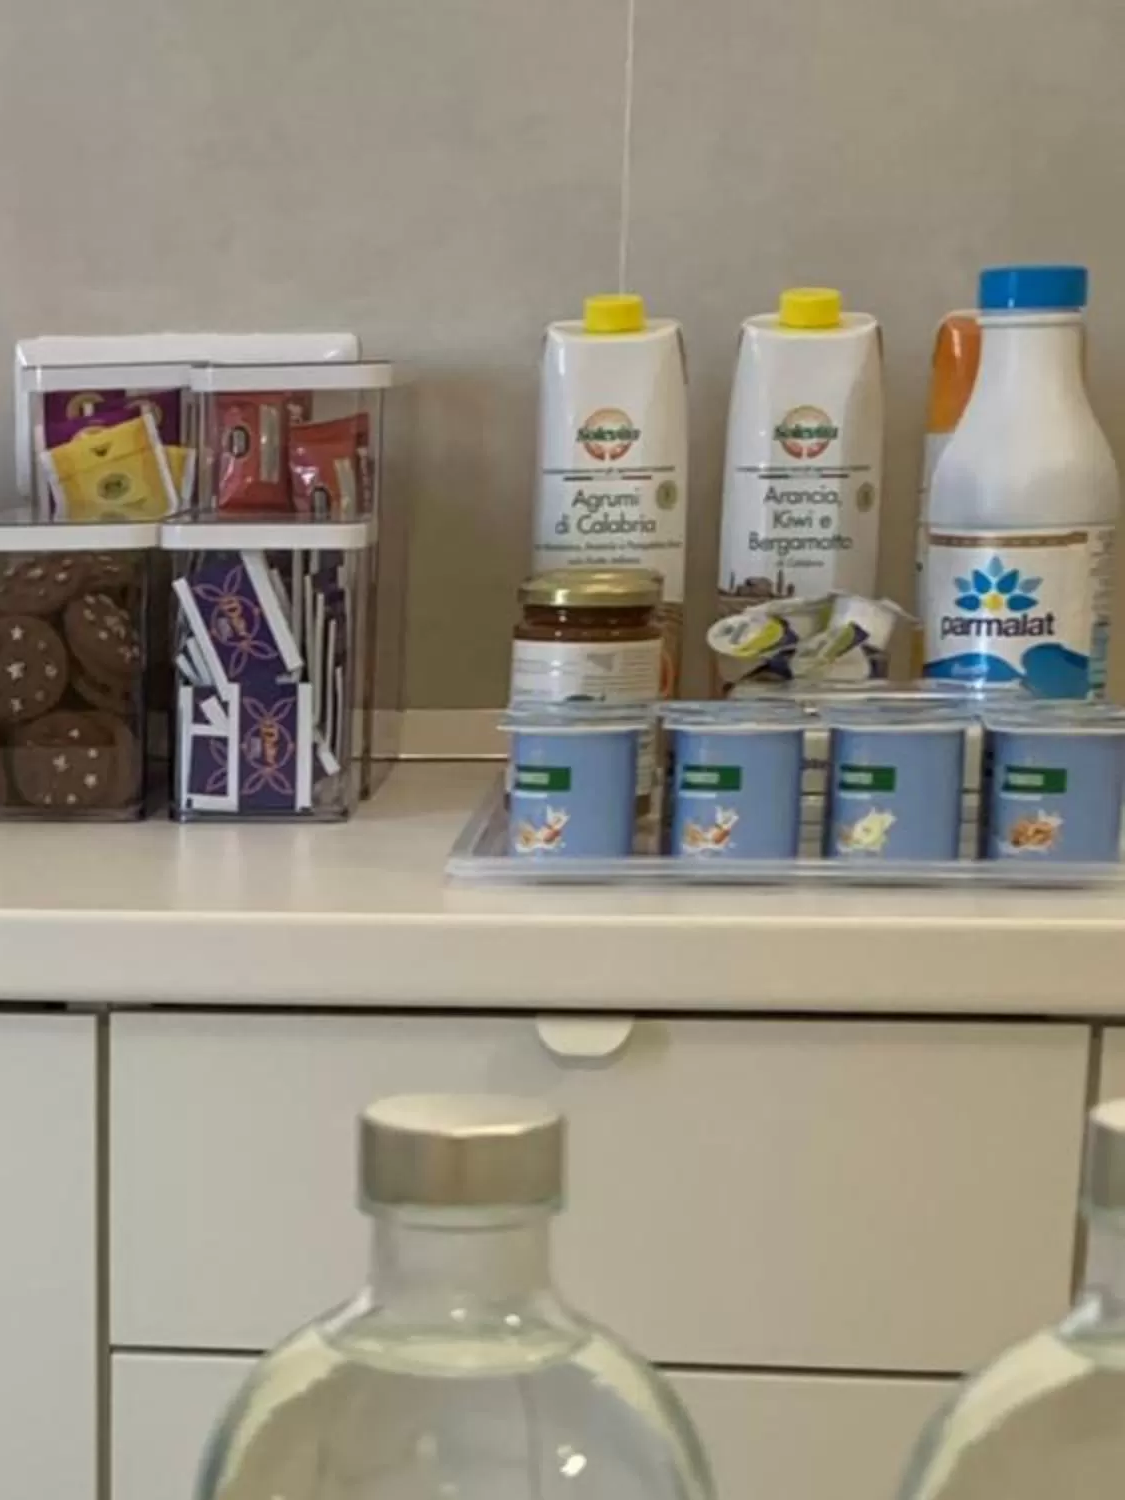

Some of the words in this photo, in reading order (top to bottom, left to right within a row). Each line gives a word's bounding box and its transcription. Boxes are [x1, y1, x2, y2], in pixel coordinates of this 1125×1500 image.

[571, 487, 641, 513] Agrumi
[763, 484, 843, 509] Arancia,
[554, 513, 571, 535] di
[576, 511, 658, 535] Calabria
[773, 508, 813, 529] Kiwi
[819, 515, 833, 529] e
[748, 531, 854, 556] Bergamotto
[941, 611, 1056, 639] parmalat
